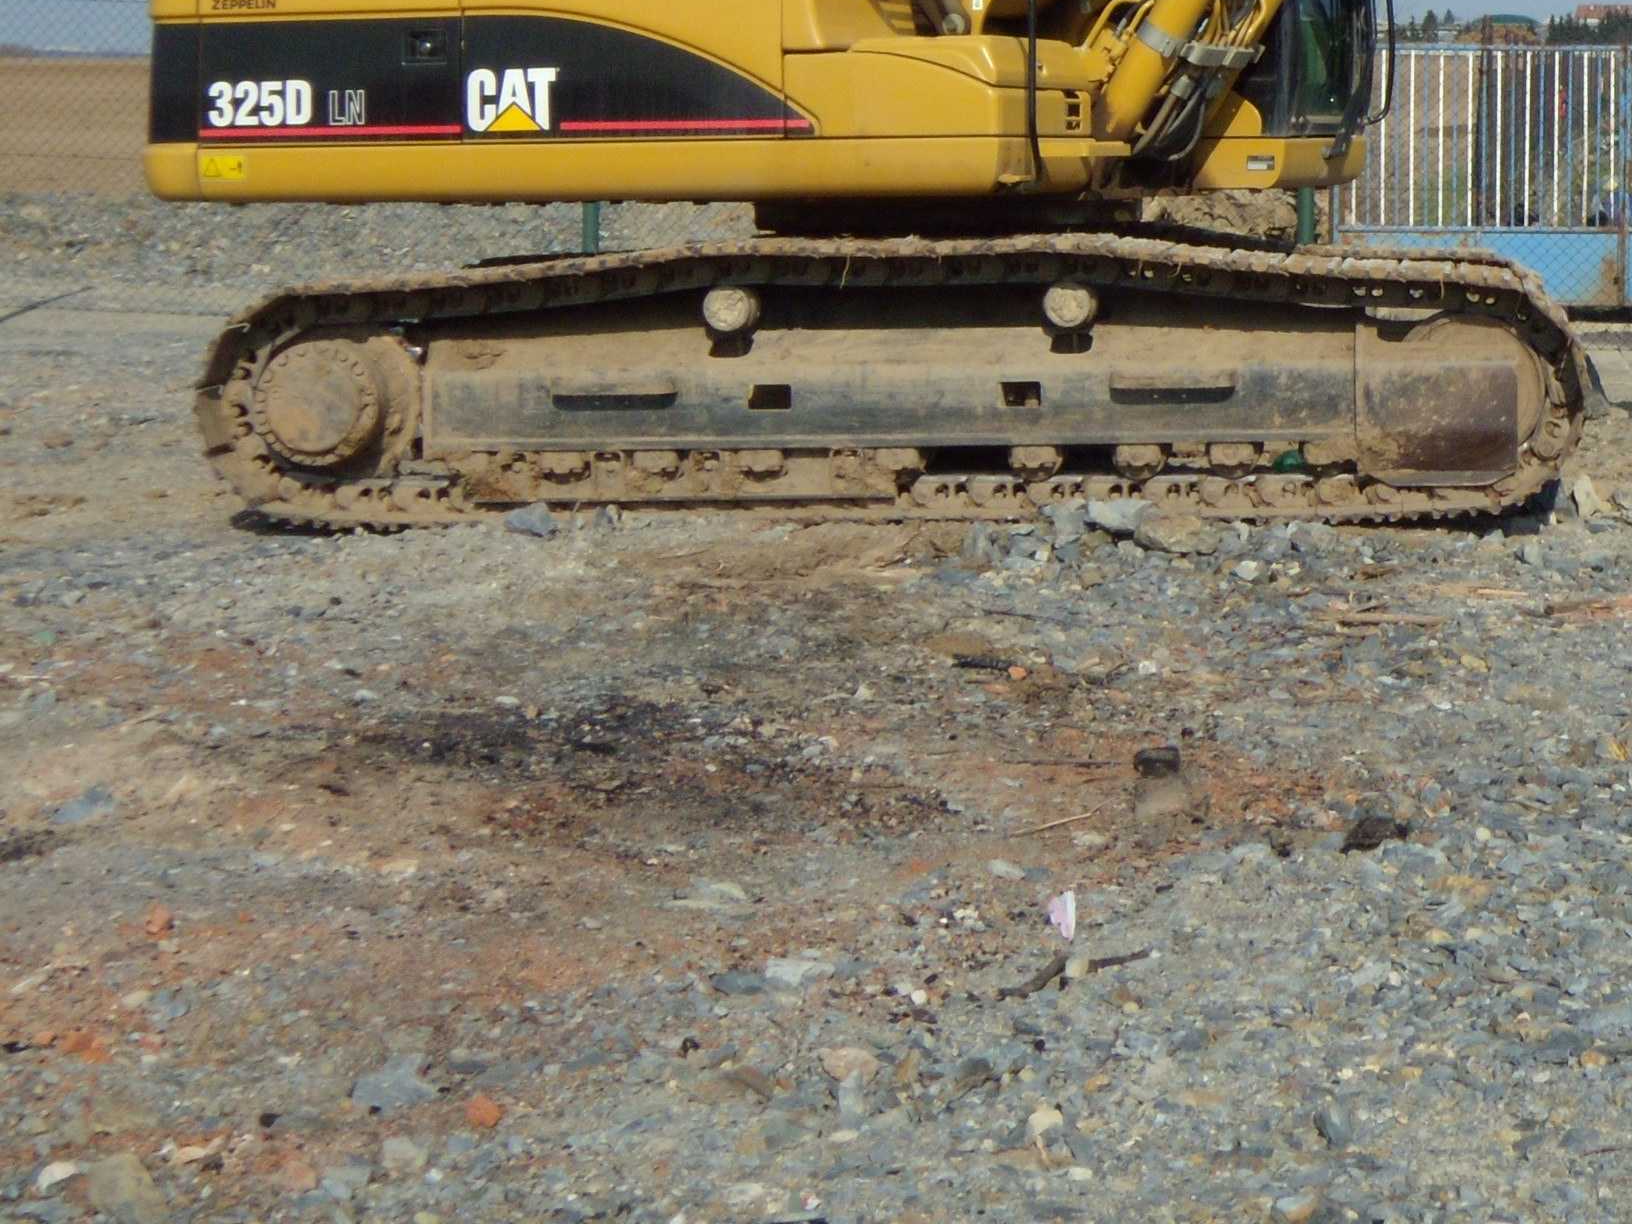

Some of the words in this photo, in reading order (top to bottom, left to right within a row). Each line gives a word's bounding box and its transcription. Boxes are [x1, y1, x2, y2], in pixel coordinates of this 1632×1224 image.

[208, 79, 312, 127] 325D
[328, 89, 366, 125] LN
[467, 67, 557, 131] CAT
